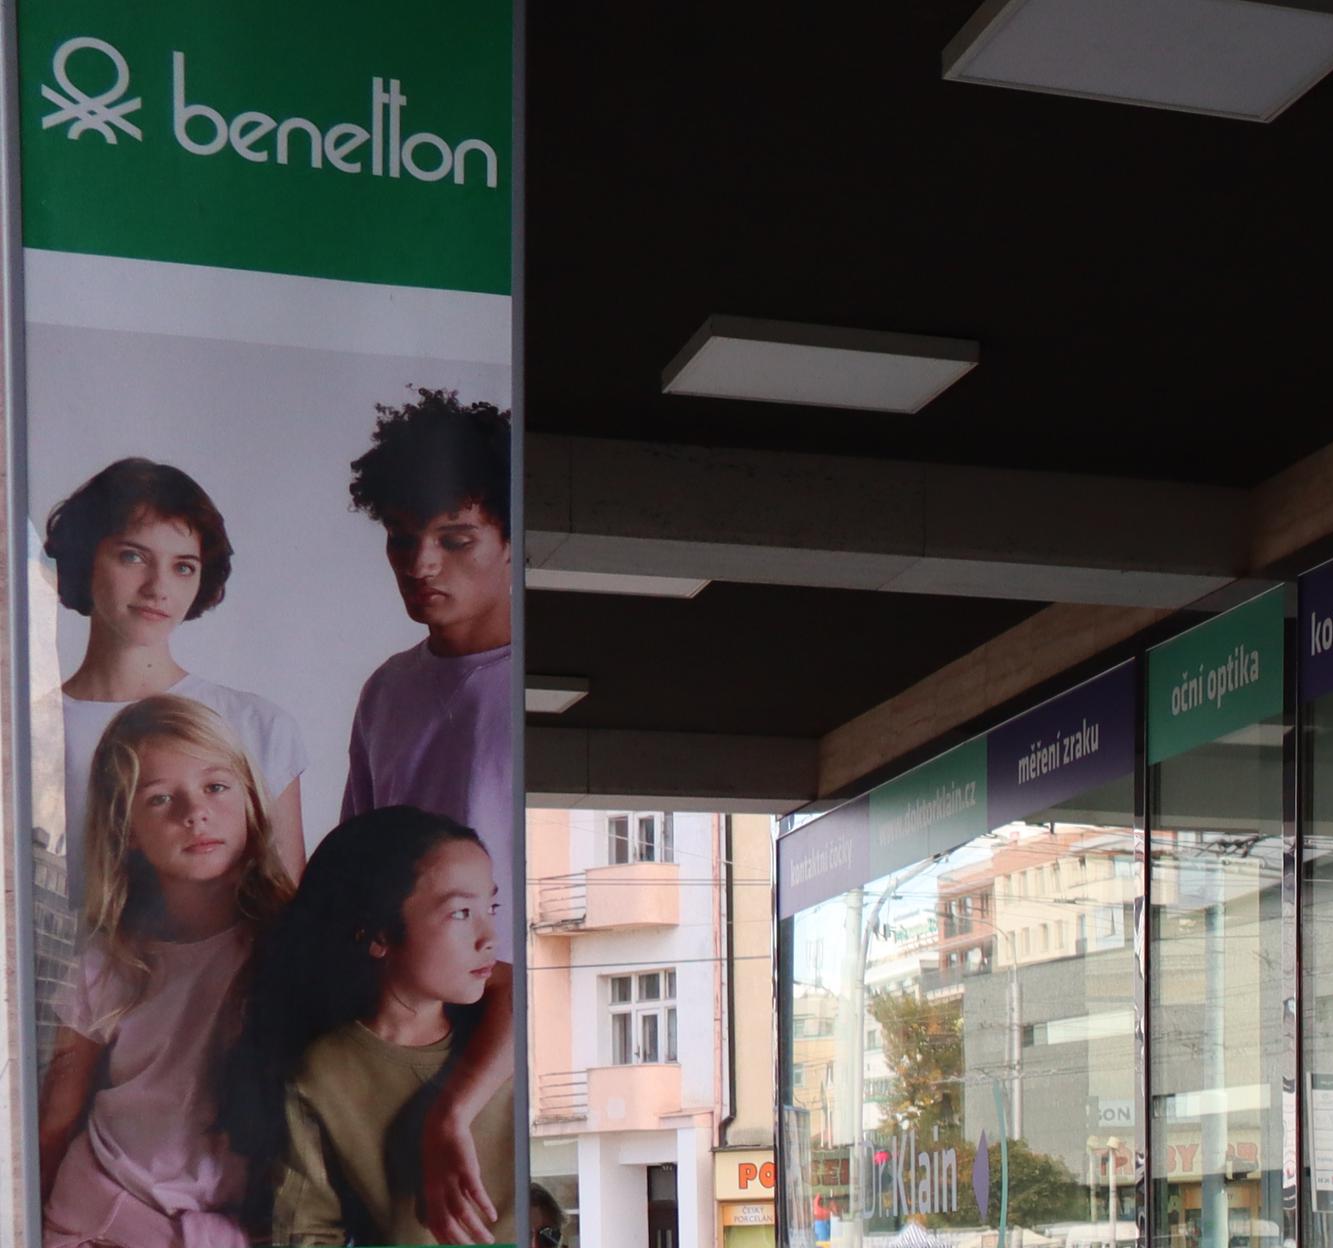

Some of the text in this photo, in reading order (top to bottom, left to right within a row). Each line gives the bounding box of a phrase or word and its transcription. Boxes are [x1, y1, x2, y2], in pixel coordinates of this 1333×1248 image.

[172, 51, 498, 188] benetton
[1171, 647, 1259, 716] oční optika
[1018, 718, 1099, 785] měření zraku
